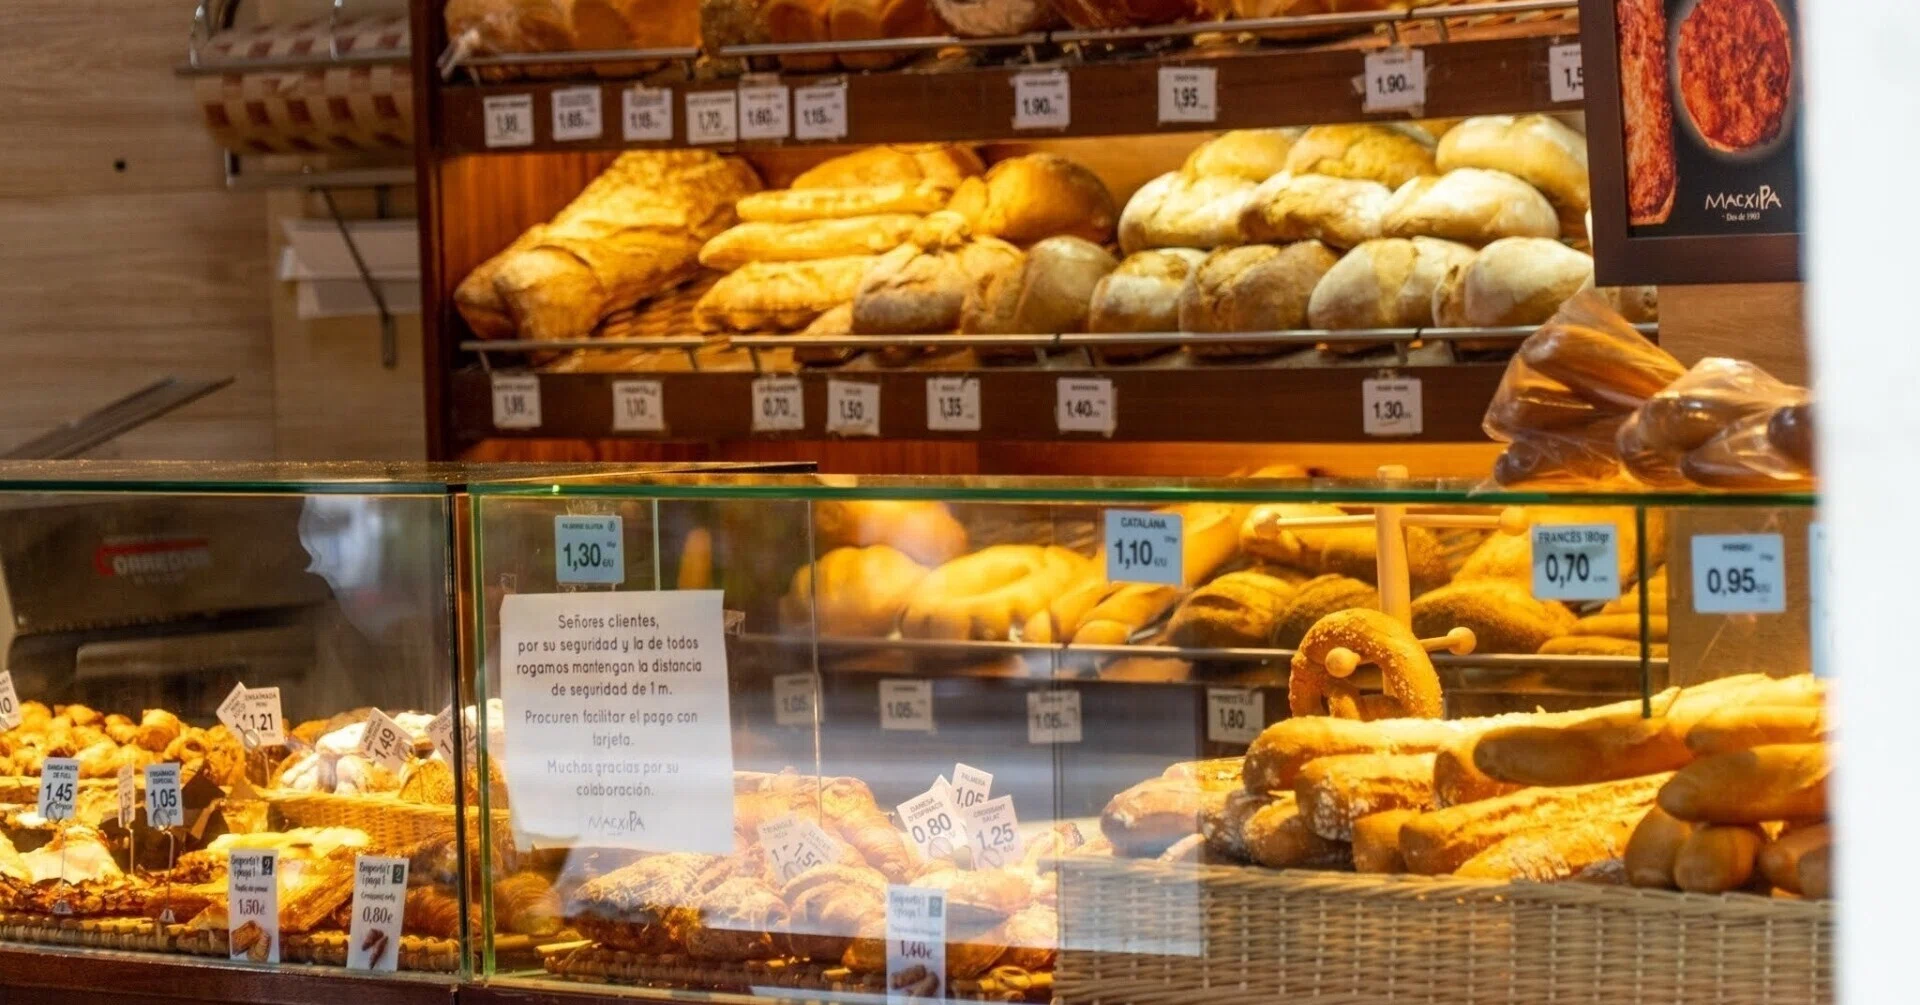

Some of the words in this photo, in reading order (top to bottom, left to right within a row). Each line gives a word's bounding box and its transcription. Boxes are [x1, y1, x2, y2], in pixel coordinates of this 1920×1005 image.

[1375, 74, 1407, 95] 1,90
[1023, 97, 1051, 116] 1,90
[1173, 87, 1199, 109] 1,95
[839, 399, 865, 421] 1,50
[1065, 400, 1093, 418] 1,40
[1373, 401, 1404, 420] 1,30
[1121, 517, 1167, 529] CATALANA
[563, 542, 601, 572] 1,30
[1114, 538, 1153, 569] 1,10
[1545, 552, 1590, 588] 0,70
[1707, 567, 1757, 596] 0,95
[558, 614, 604, 630] Señores
[608, 613, 660, 629] clientes,
[518, 640, 539, 656] por
[543, 641, 556, 652] su
[560, 637, 618, 655] seguridad
[622, 640, 629, 653] y
[633, 637, 644, 650] la
[648, 636, 663, 650] de
[667, 635, 699, 650] todos
[517, 662, 569, 678] rogamos
[572, 660, 635, 676] mantengan
[638, 659, 649, 673] la
[652, 659, 702, 673] distancia
[551, 682, 566, 697] de
[570, 682, 628, 699] seguridad
[632, 682, 646, 696] de
[650, 681, 656, 695] 1
[658, 684, 673, 696] m.
[249, 712, 274, 731] 1,21
[525, 709, 579, 725] Procuren
[583, 709, 626, 724] facilitar
[629, 709, 640, 723] el
[643, 711, 673, 727] pago
[677, 711, 698, 723] con
[374, 727, 396, 760] 1,49
[593, 732, 635, 750] tarjeta.
[547, 759, 593, 774] Muchas
[595, 760, 639, 777] gracias
[643, 761, 662, 777] por
[666, 761, 680, 774] su
[45, 782, 73, 802] 1,45
[150, 788, 177, 809] 1,05
[576, 782, 654, 797] colaboración.
[976, 822, 1015, 850] 1,25
[238, 898, 265, 915] 1,50€
[362, 905, 393, 923] 0,80€
[901, 939, 933, 960] 1,40€
